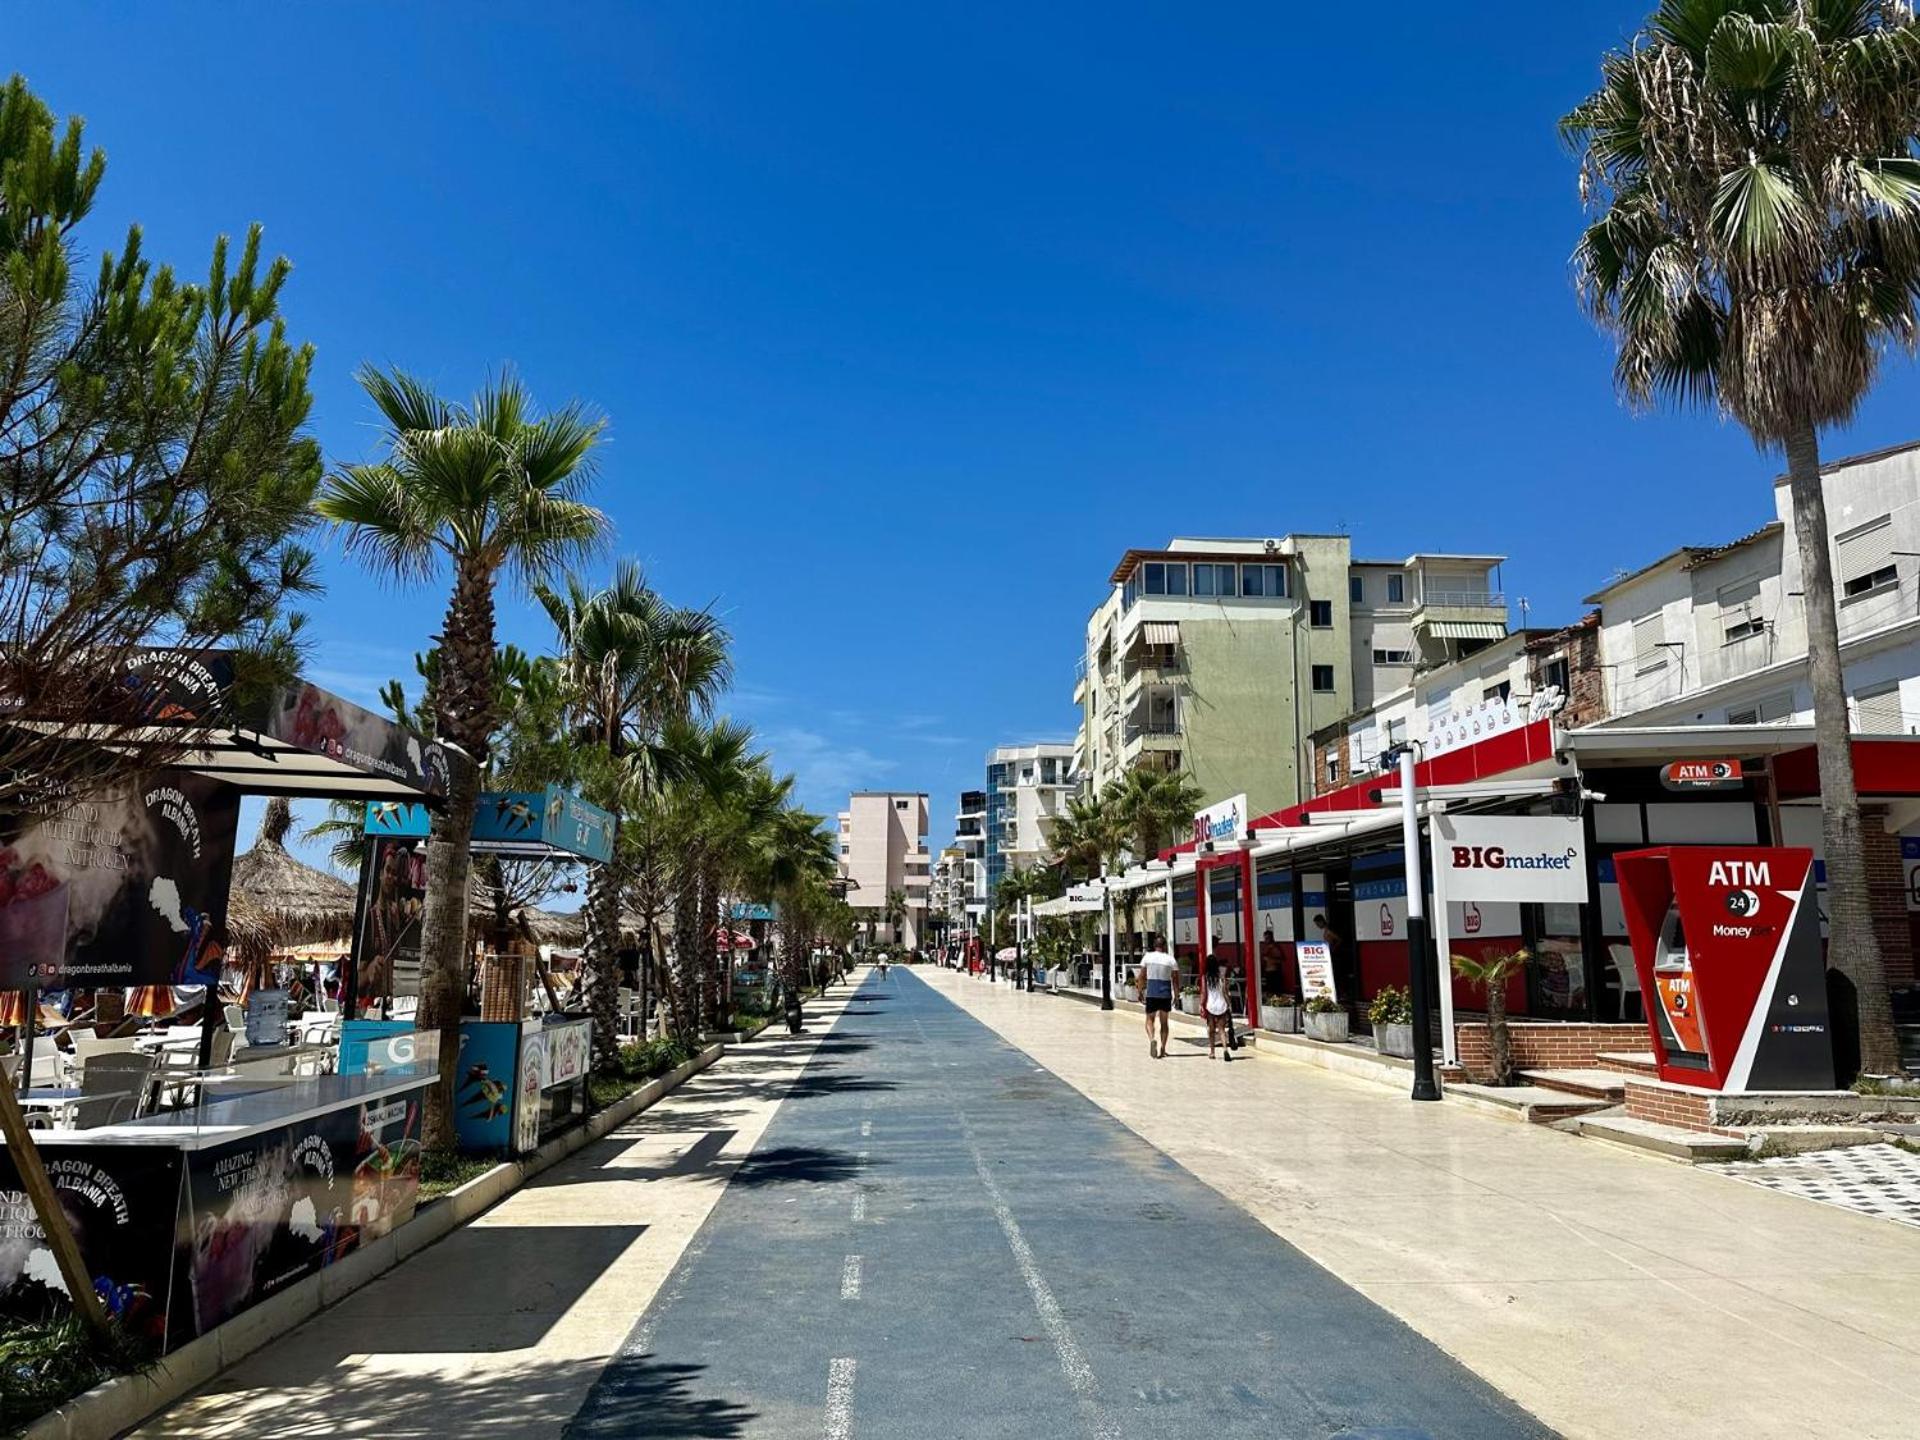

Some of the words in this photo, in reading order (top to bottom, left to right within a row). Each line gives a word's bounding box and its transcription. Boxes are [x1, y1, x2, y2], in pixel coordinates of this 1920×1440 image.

[1679, 765, 1708, 778] ATM
[145, 787, 185, 808] DRAGON
[183, 800, 201, 860] BREATH
[162, 803, 191, 841] ALBANIA
[1708, 860, 1771, 887] ATM
[1730, 897, 1746, 910] 24
[1713, 924, 1770, 940] Money
[1303, 946, 1325, 955] BIG
[1668, 978, 1691, 993] ATM
[212, 1150, 254, 1178] AMAZING
[42, 1160, 93, 1176] RAGON
[93, 1168, 130, 1225] BREATH
[55, 1174, 108, 1208] ALBANIA
[218, 1170, 239, 1193] NEW
